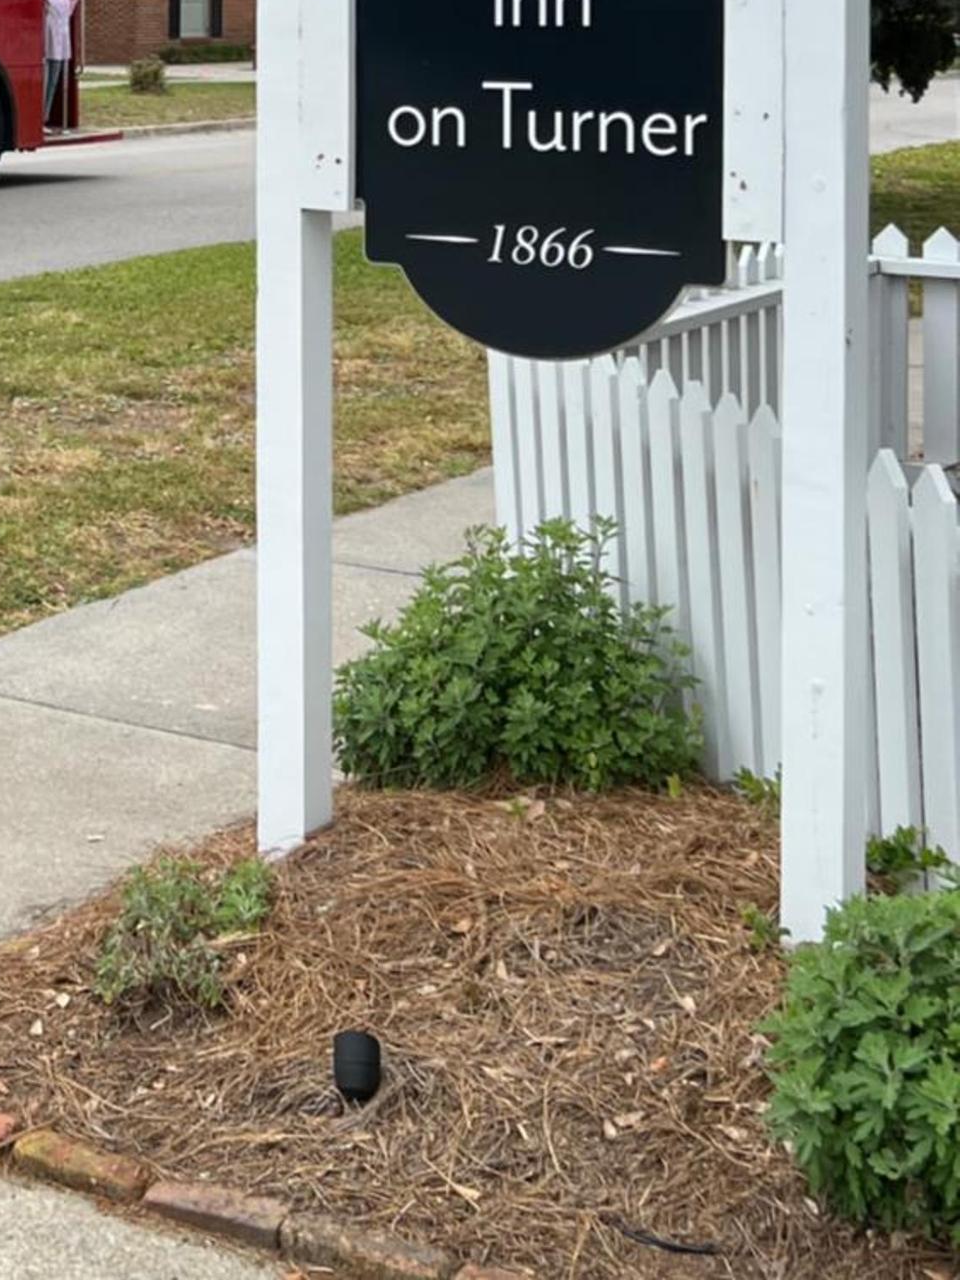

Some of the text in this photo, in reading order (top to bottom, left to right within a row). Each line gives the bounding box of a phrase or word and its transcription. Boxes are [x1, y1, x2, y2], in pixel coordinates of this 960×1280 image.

[387, 81, 709, 157] on Turner
[487, 224, 595, 269] 1866
